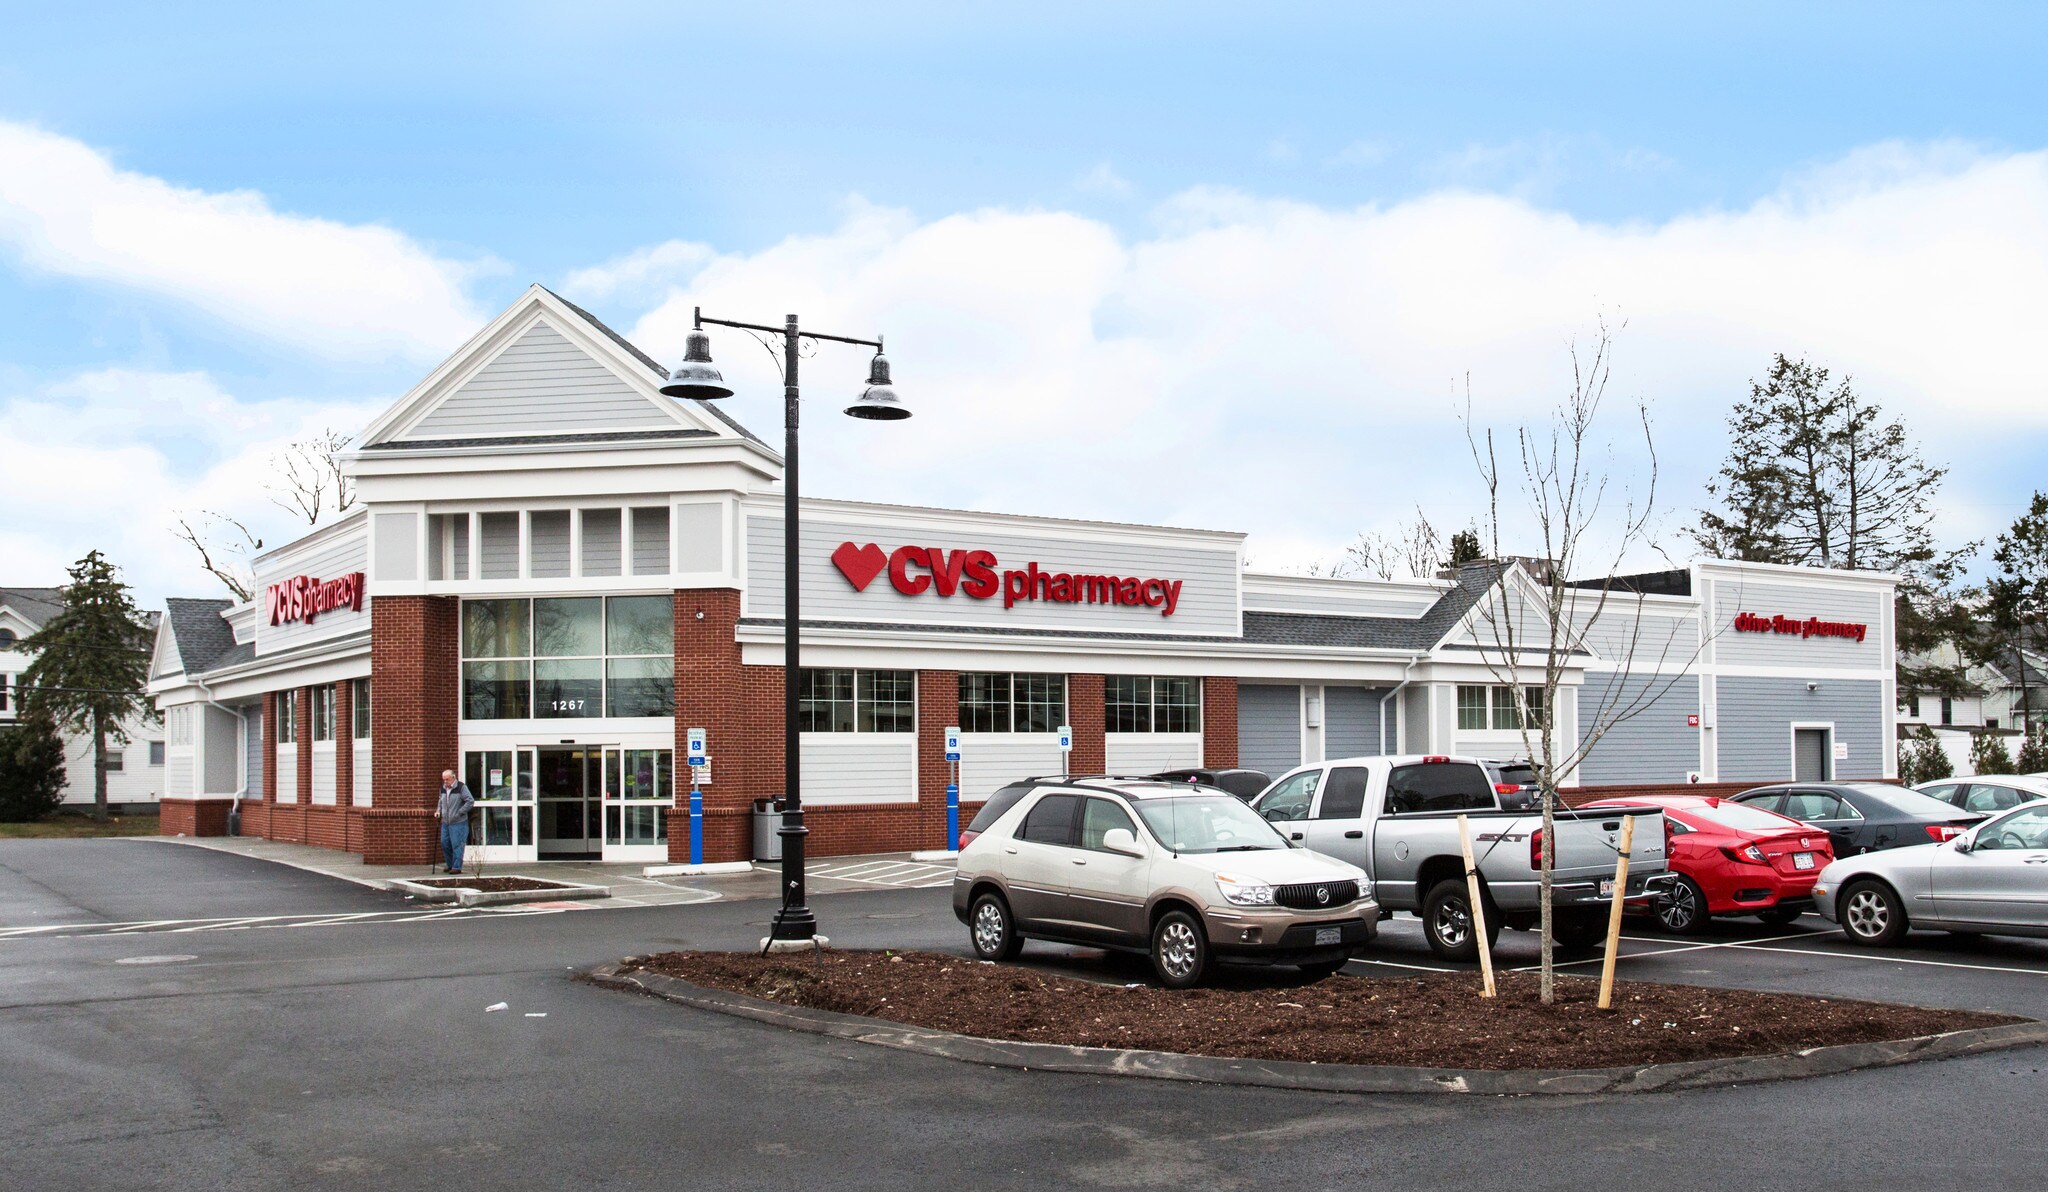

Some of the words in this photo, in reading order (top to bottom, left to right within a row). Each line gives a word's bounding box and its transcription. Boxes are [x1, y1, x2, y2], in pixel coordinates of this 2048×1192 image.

[888, 545, 1000, 599] CVS
[1004, 561, 1183, 616] pharmacy
[277, 575, 308, 625] CVS
[303, 572, 363, 625] pharmacy
[1803, 616, 1867, 643] pharmacy
[552, 700, 584, 711] 1267
[1689, 716, 1698, 724] FDC
[1476, 833, 1530, 843] SXT
